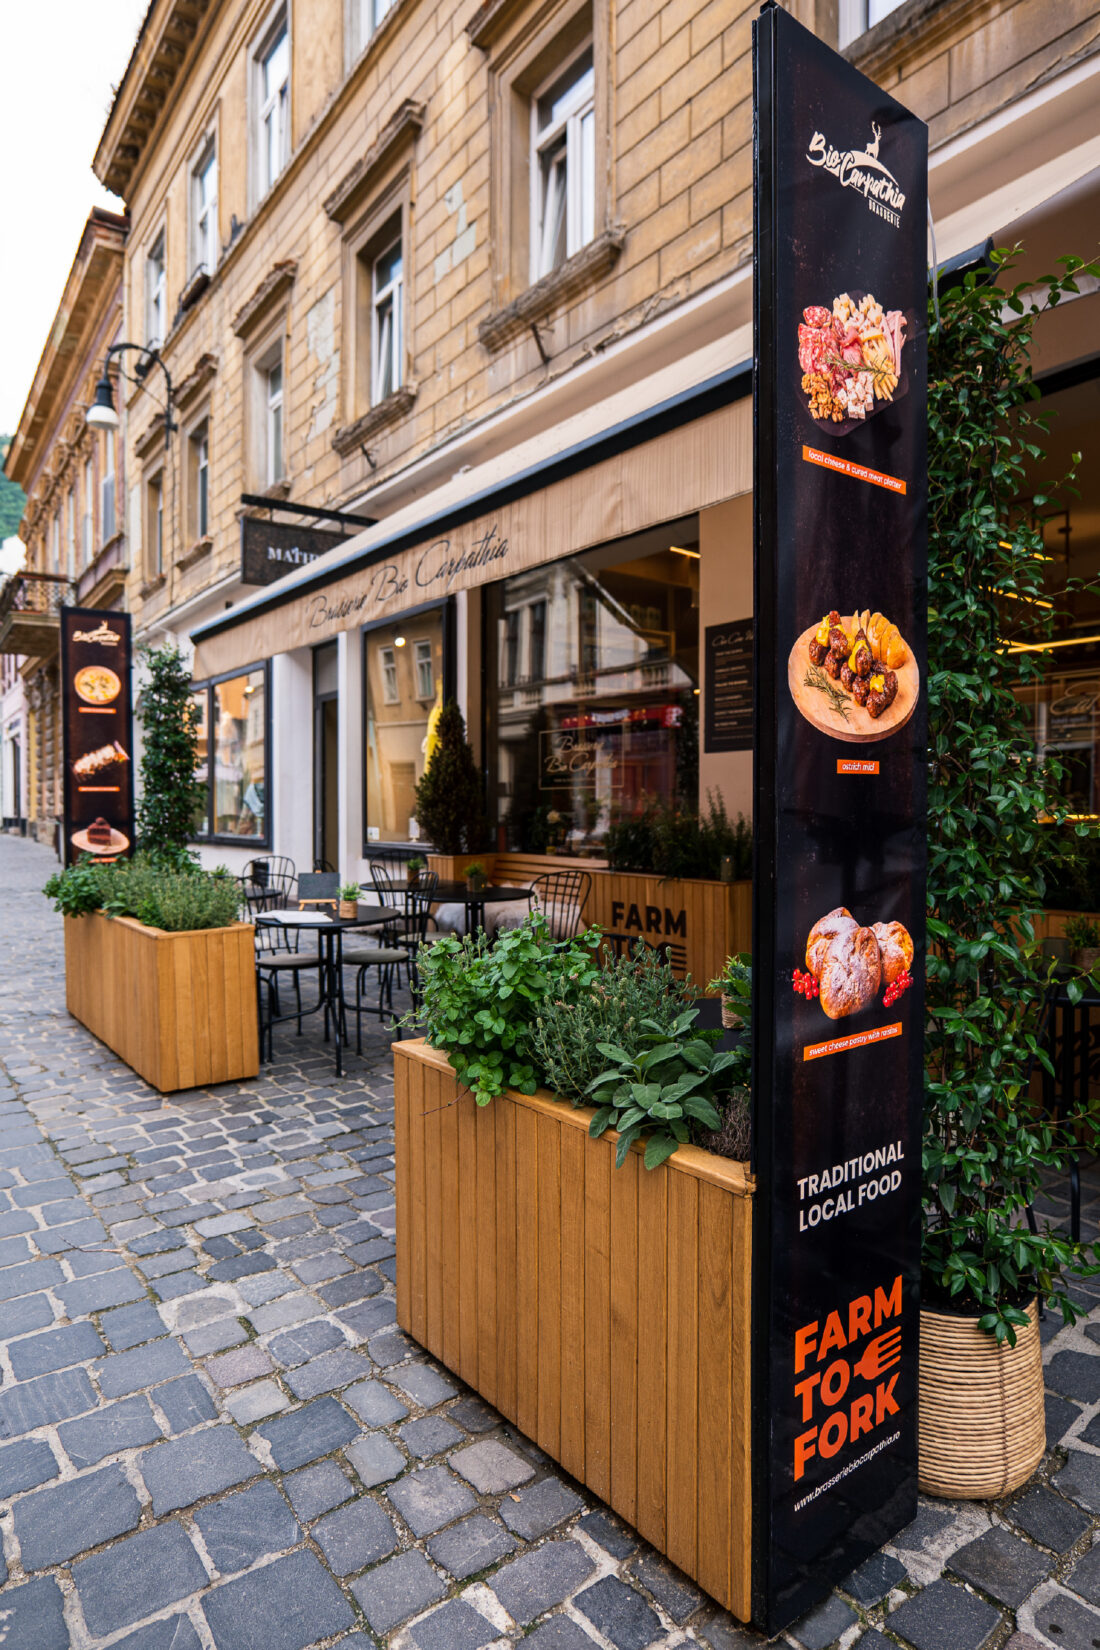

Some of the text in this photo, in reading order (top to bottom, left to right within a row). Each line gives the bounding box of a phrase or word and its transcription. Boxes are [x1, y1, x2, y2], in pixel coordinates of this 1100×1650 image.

[806, 131, 906, 211] Bio Carpathia
[868, 199, 900, 228] BRASSERIE
[808, 449, 902, 489] local cheese & cured meat platter
[371, 566, 408, 602] Bio
[415, 523, 509, 591] Carpathia
[842, 762, 861, 771] ostrich
[612, 901, 687, 938] FARM
[809, 1026, 898, 1057] sweet cheese pastry with raisins
[797, 1140, 905, 1200] TRADITIONAL
[799, 1170, 902, 1232] LOCAL FOOD
[795, 1274, 903, 1375] FARM
[795, 1358, 850, 1424] TO
[794, 1371, 901, 1482] FORK
[794, 1431, 901, 1512] www.brasseriebiocarpathia.ro
